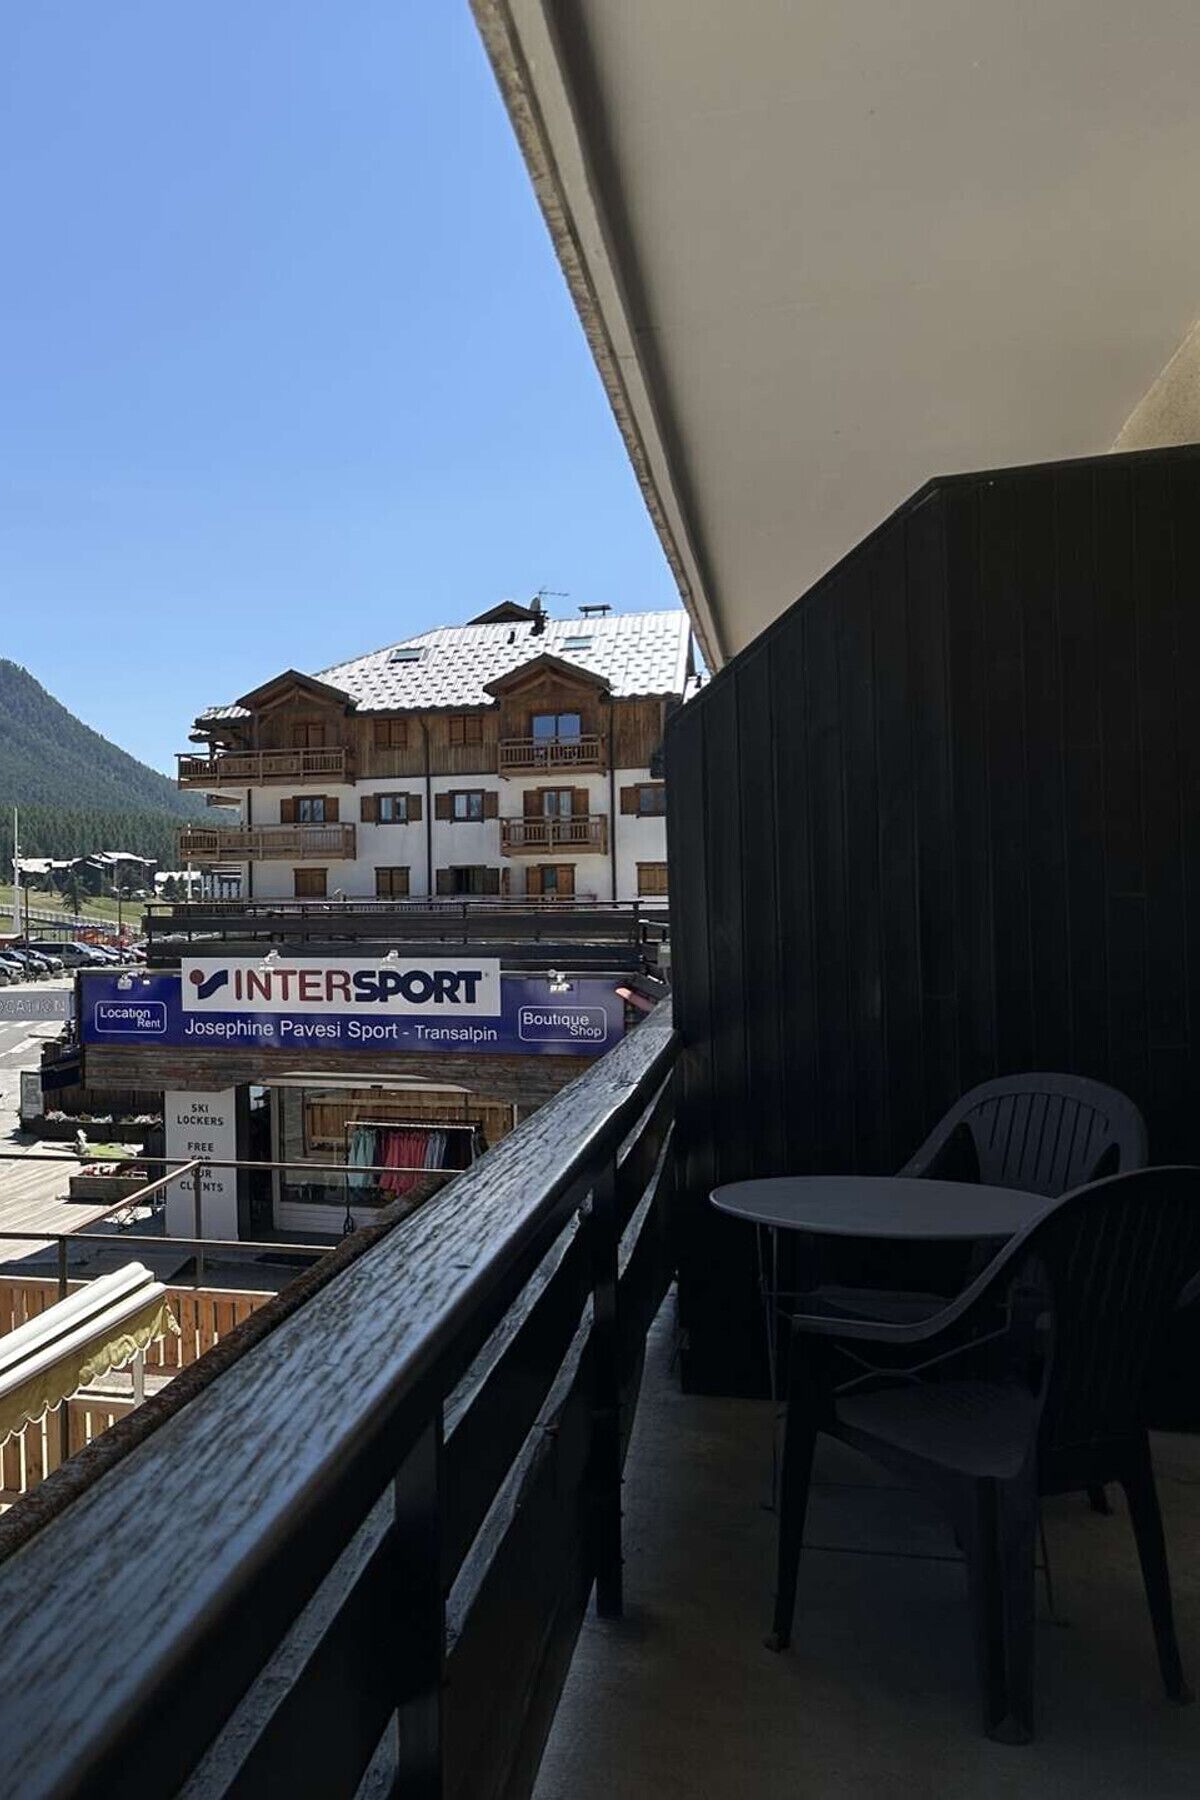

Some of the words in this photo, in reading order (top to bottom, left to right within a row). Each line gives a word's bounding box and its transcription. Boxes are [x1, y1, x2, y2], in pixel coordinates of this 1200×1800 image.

[234, 969, 483, 1004] INTERSPORT
[100, 1006, 151, 1019] Location
[137, 1017, 161, 1028] Rent
[523, 1011, 589, 1028] Boutique
[184, 1018, 274, 1039] Josephine
[280, 1019, 341, 1037] Pavesi
[347, 1021, 399, 1040] Sport
[414, 1025, 498, 1041] Transalpin
[569, 1025, 602, 1038] Shop
[191, 1103, 209, 1114] SKI
[177, 1115, 224, 1126] LOCKERS
[187, 1142, 214, 1153] FREE
[180, 1181, 224, 1192] CLNTS
